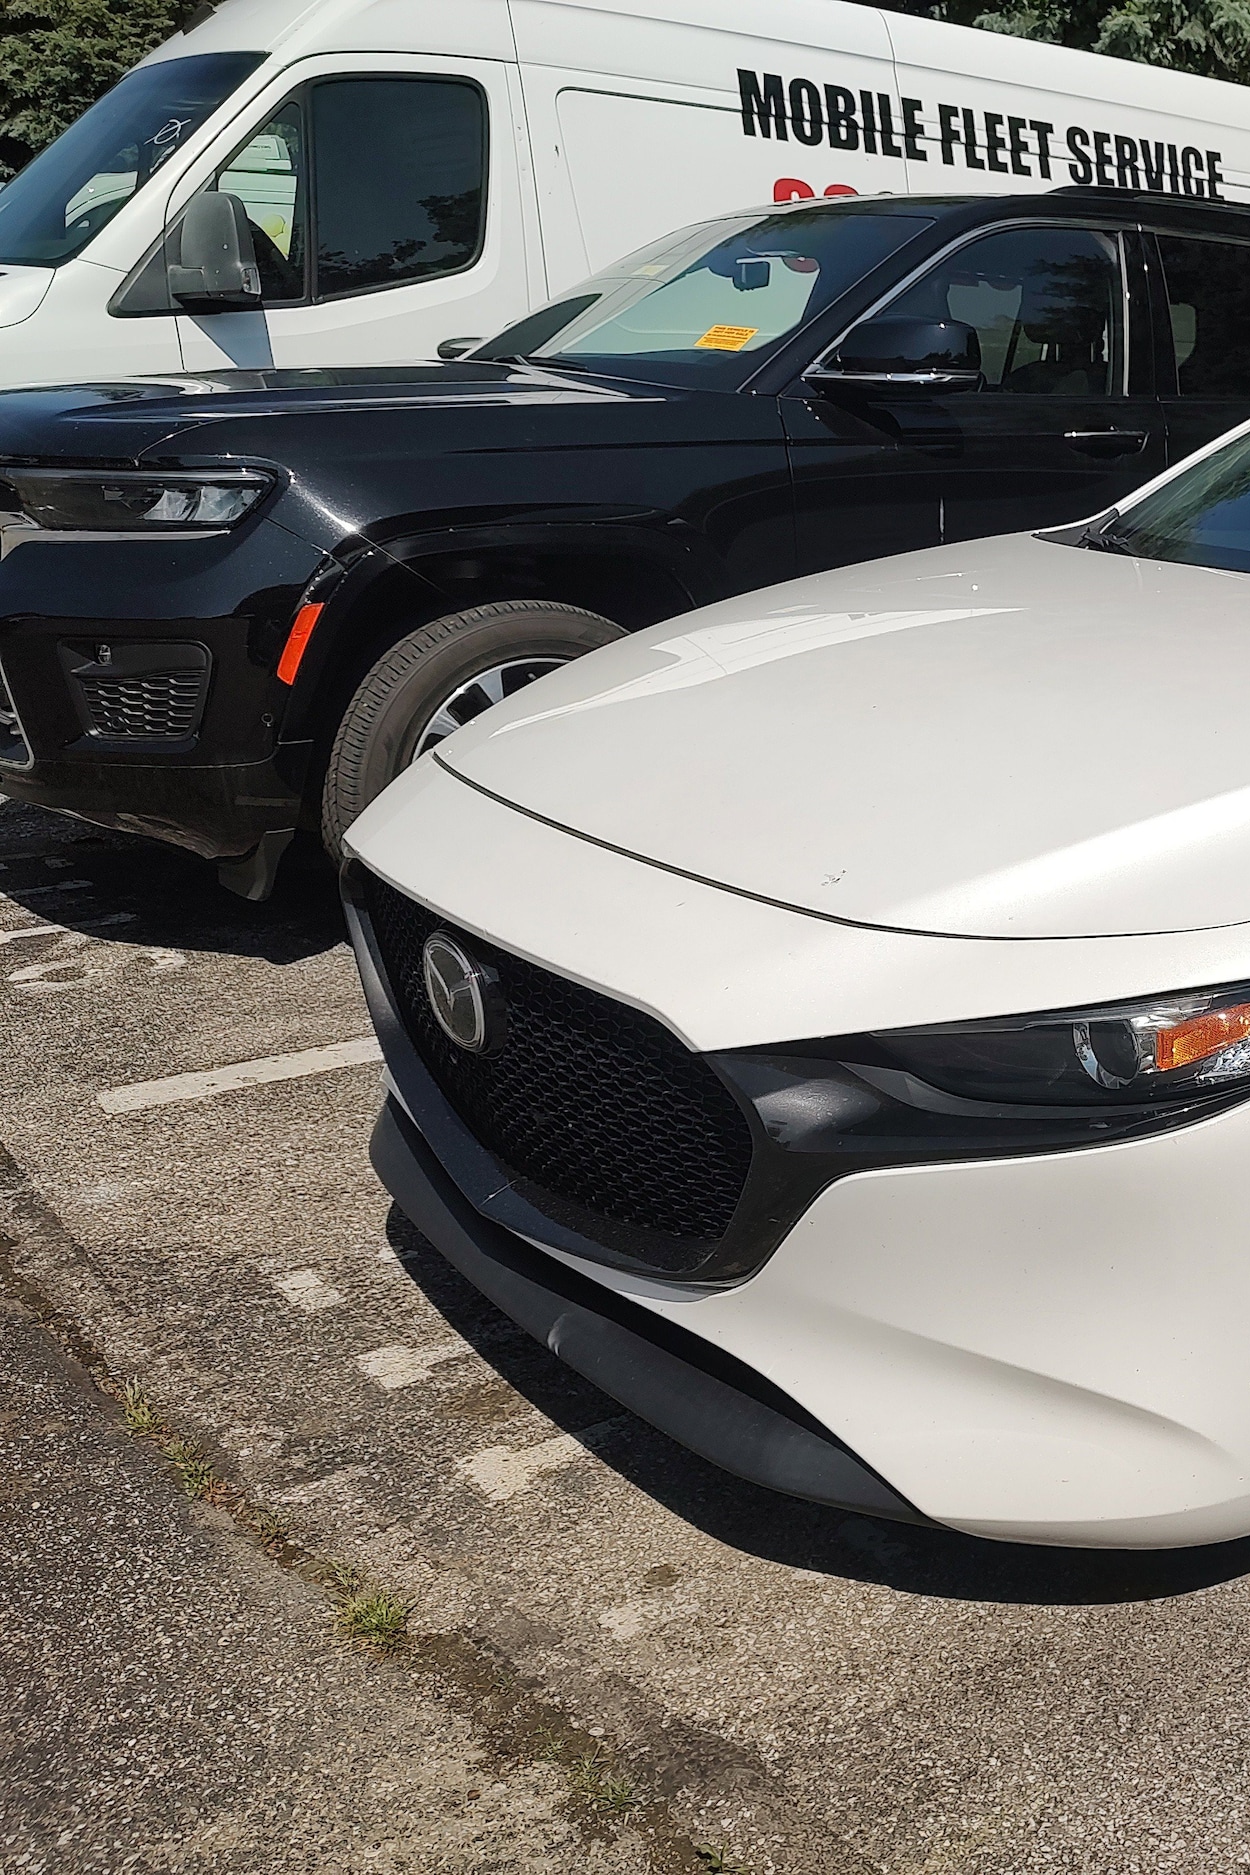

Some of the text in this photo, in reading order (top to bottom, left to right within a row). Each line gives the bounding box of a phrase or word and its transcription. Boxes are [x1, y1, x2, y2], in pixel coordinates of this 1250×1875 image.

[736, 68, 1225, 200] MOBILE FLEET SERVICE
